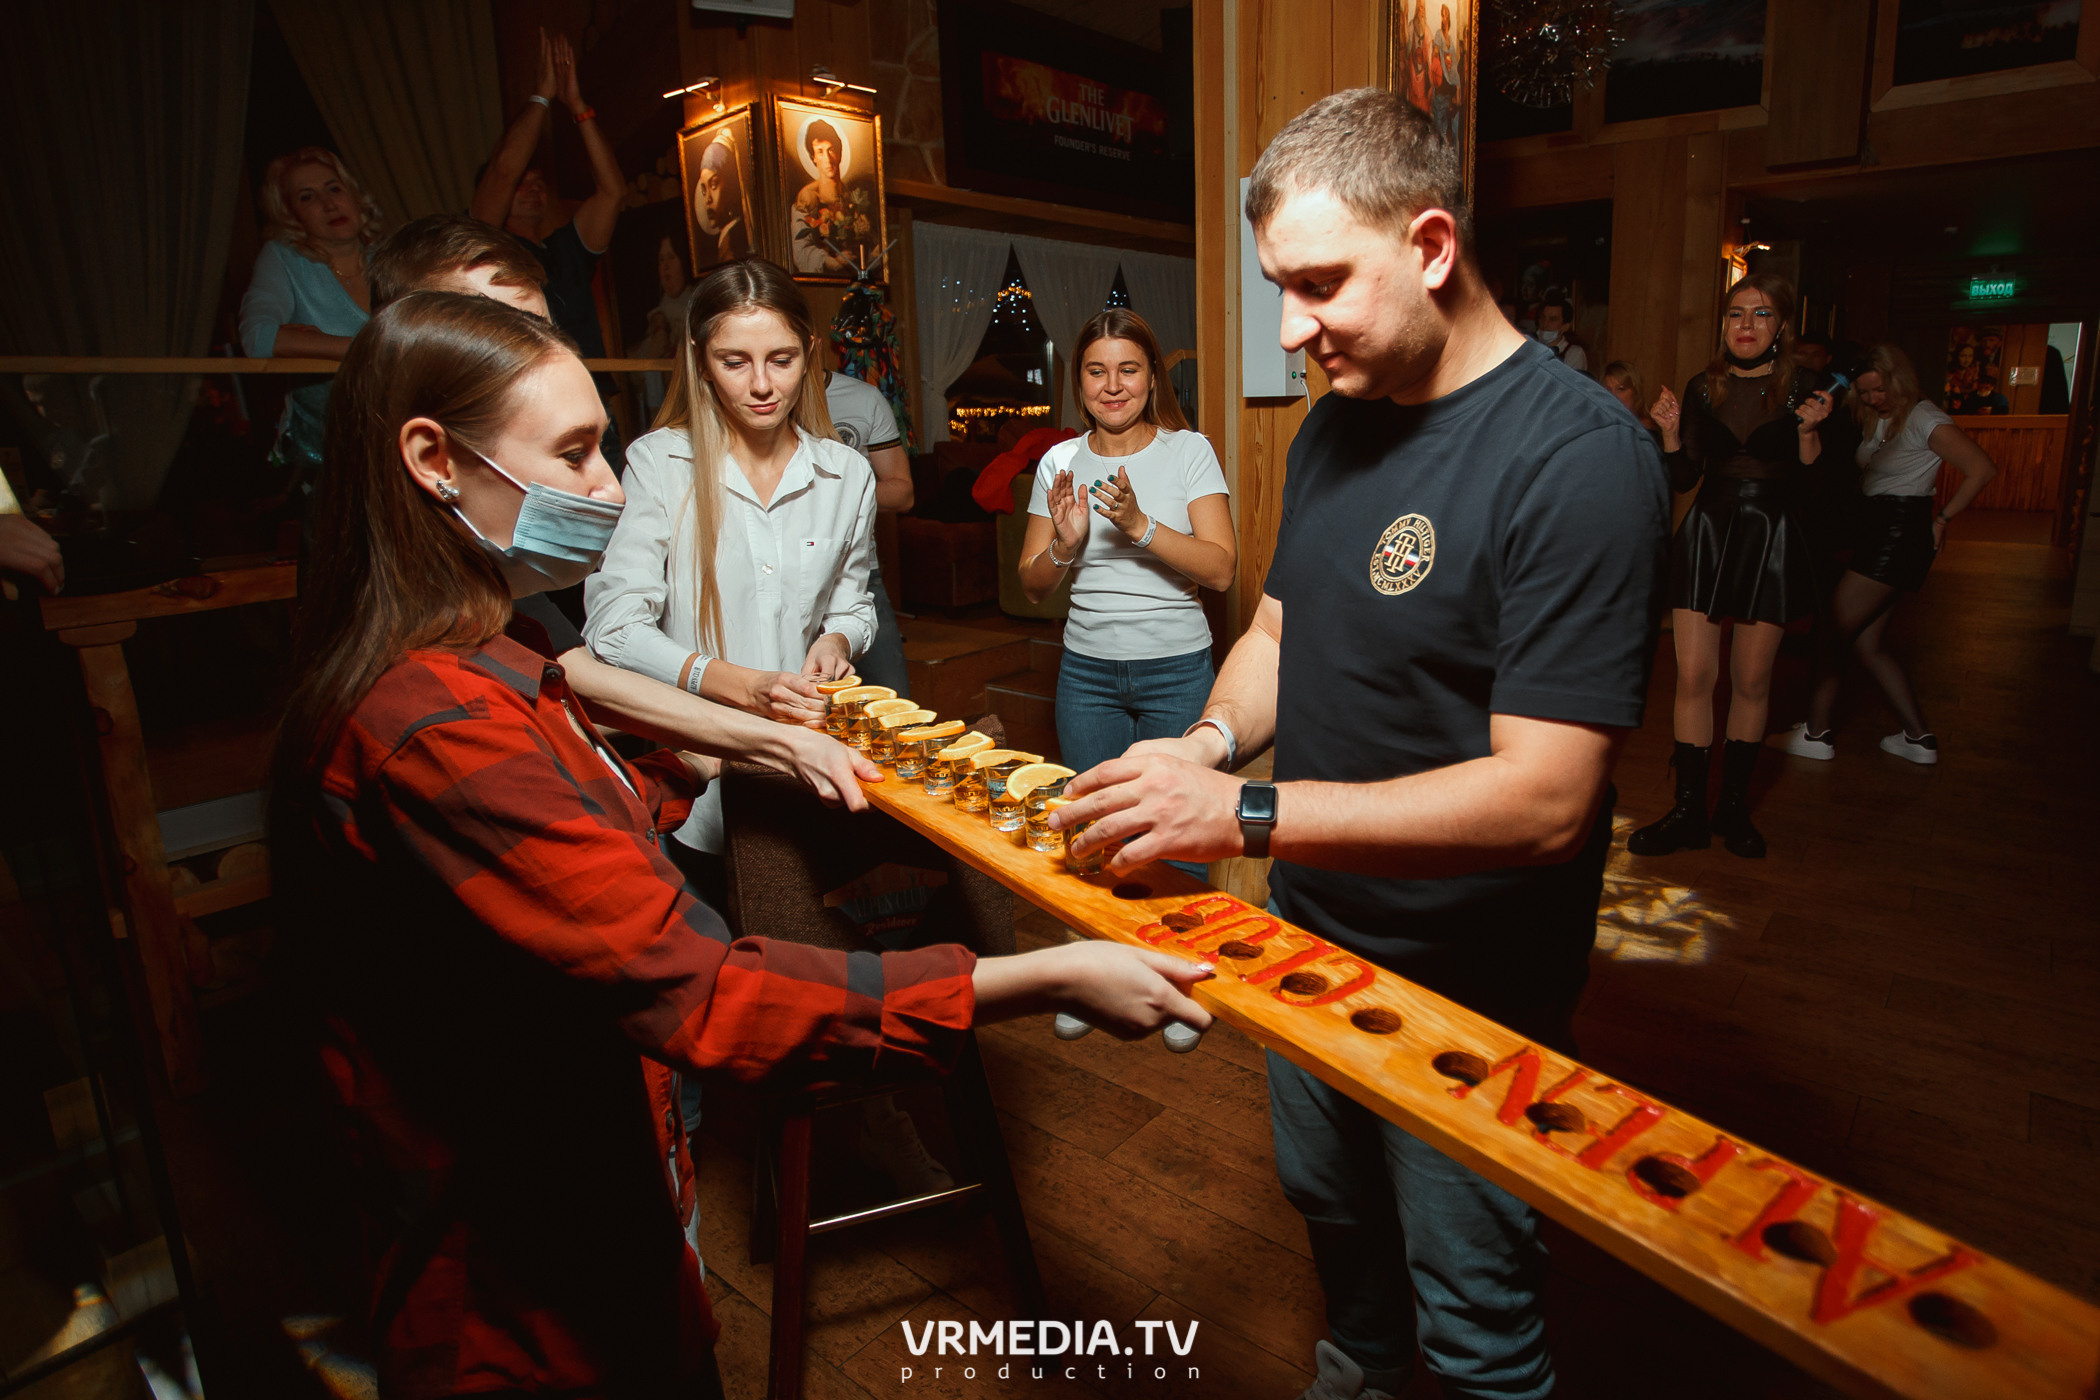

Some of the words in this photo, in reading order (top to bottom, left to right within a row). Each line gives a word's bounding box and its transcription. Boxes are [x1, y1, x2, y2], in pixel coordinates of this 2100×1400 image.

[1079, 83, 1105, 106] THE
[1046, 96, 1134, 140] GLENLIVET
[1054, 135, 1097, 154] FOUNDER'S
[1099, 145, 1131, 161] RESERVE
[1971, 282, 2014, 297] ВЫХОД
[1381, 518, 1412, 545] TOMMY
